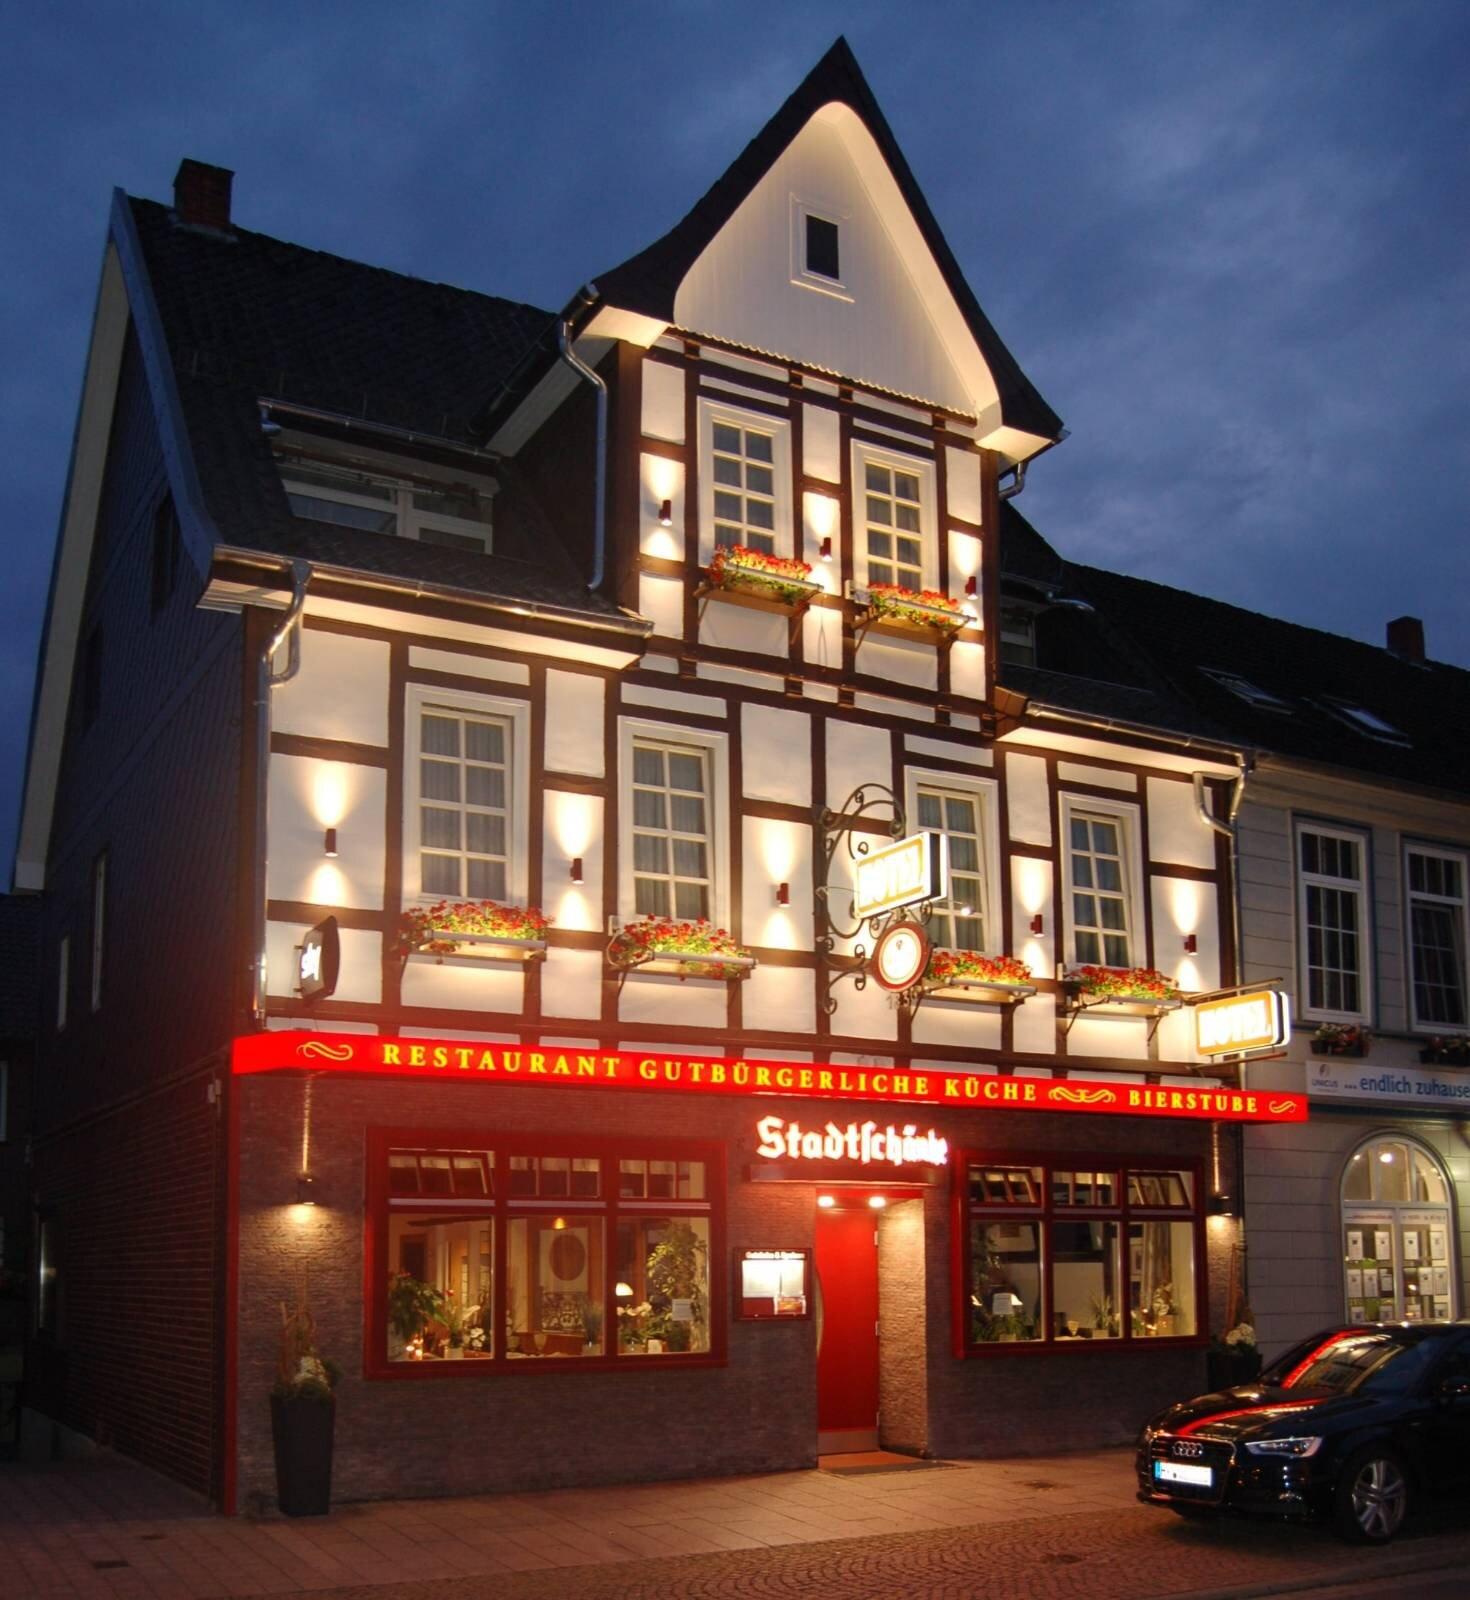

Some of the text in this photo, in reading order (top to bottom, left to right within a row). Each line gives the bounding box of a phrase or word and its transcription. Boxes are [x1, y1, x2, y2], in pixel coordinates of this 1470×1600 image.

[382, 1042, 1257, 1114] RESTAURANT GUTBÜRGERLICHE KÜCHE BIERSTUBE
[1359, 1074, 1412, 1094] endlich
[1415, 1077, 1470, 1098] zuhause
